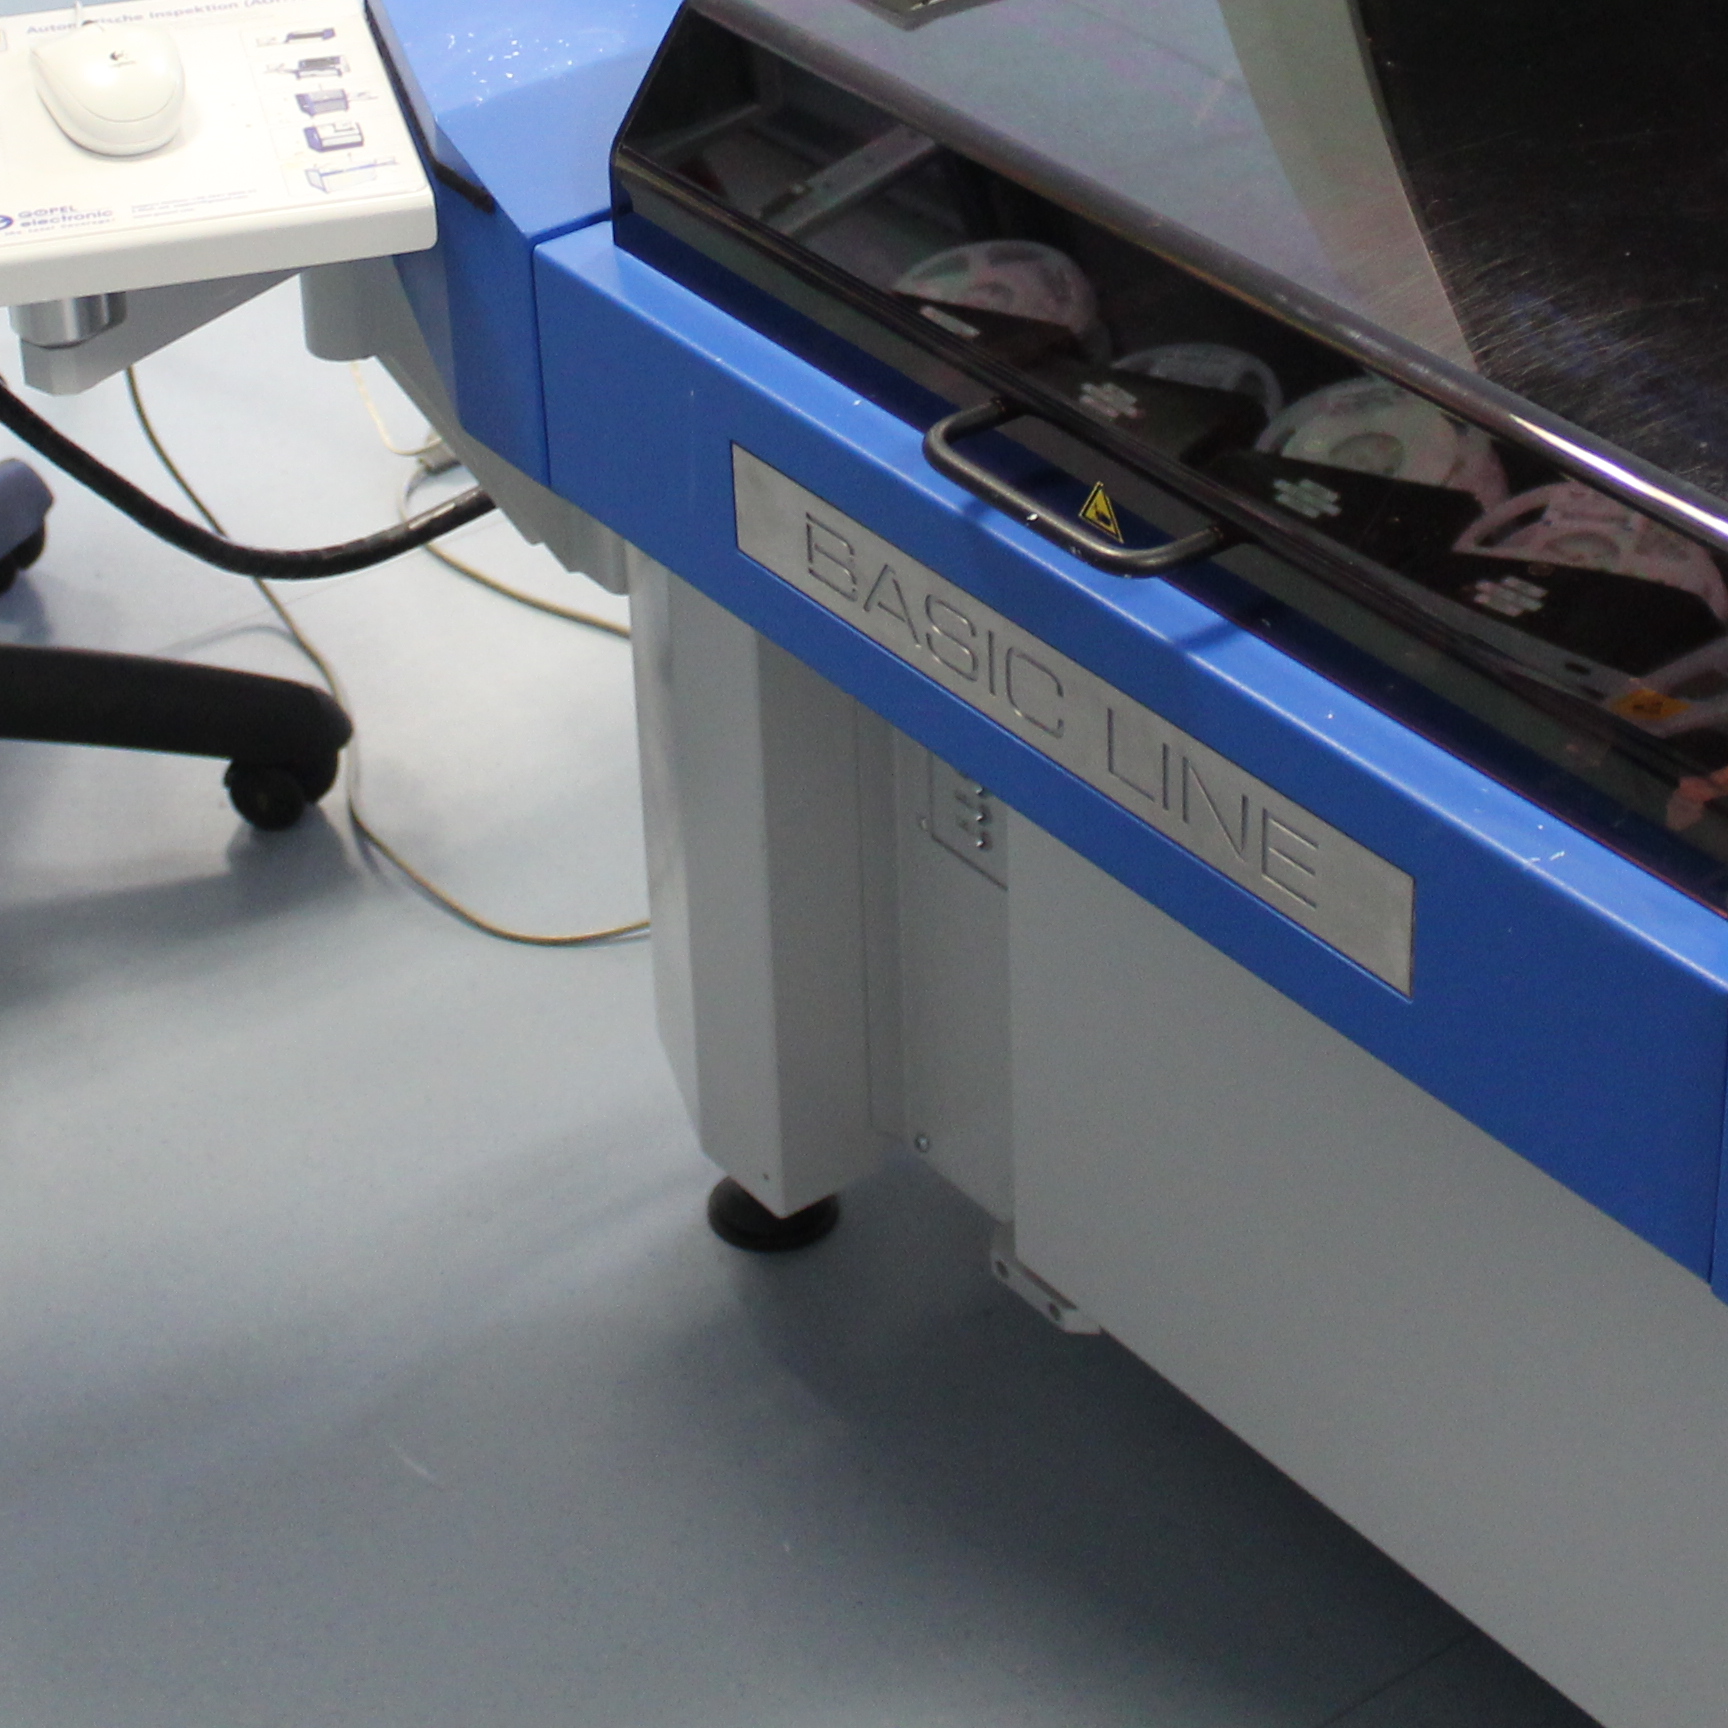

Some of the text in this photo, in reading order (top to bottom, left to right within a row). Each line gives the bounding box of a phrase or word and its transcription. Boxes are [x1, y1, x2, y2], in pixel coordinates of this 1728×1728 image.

[149, 2, 239, 21] Inspektion
[20, 210, 114, 228] electronic
[806, 510, 1320, 910] BASIC LINE
